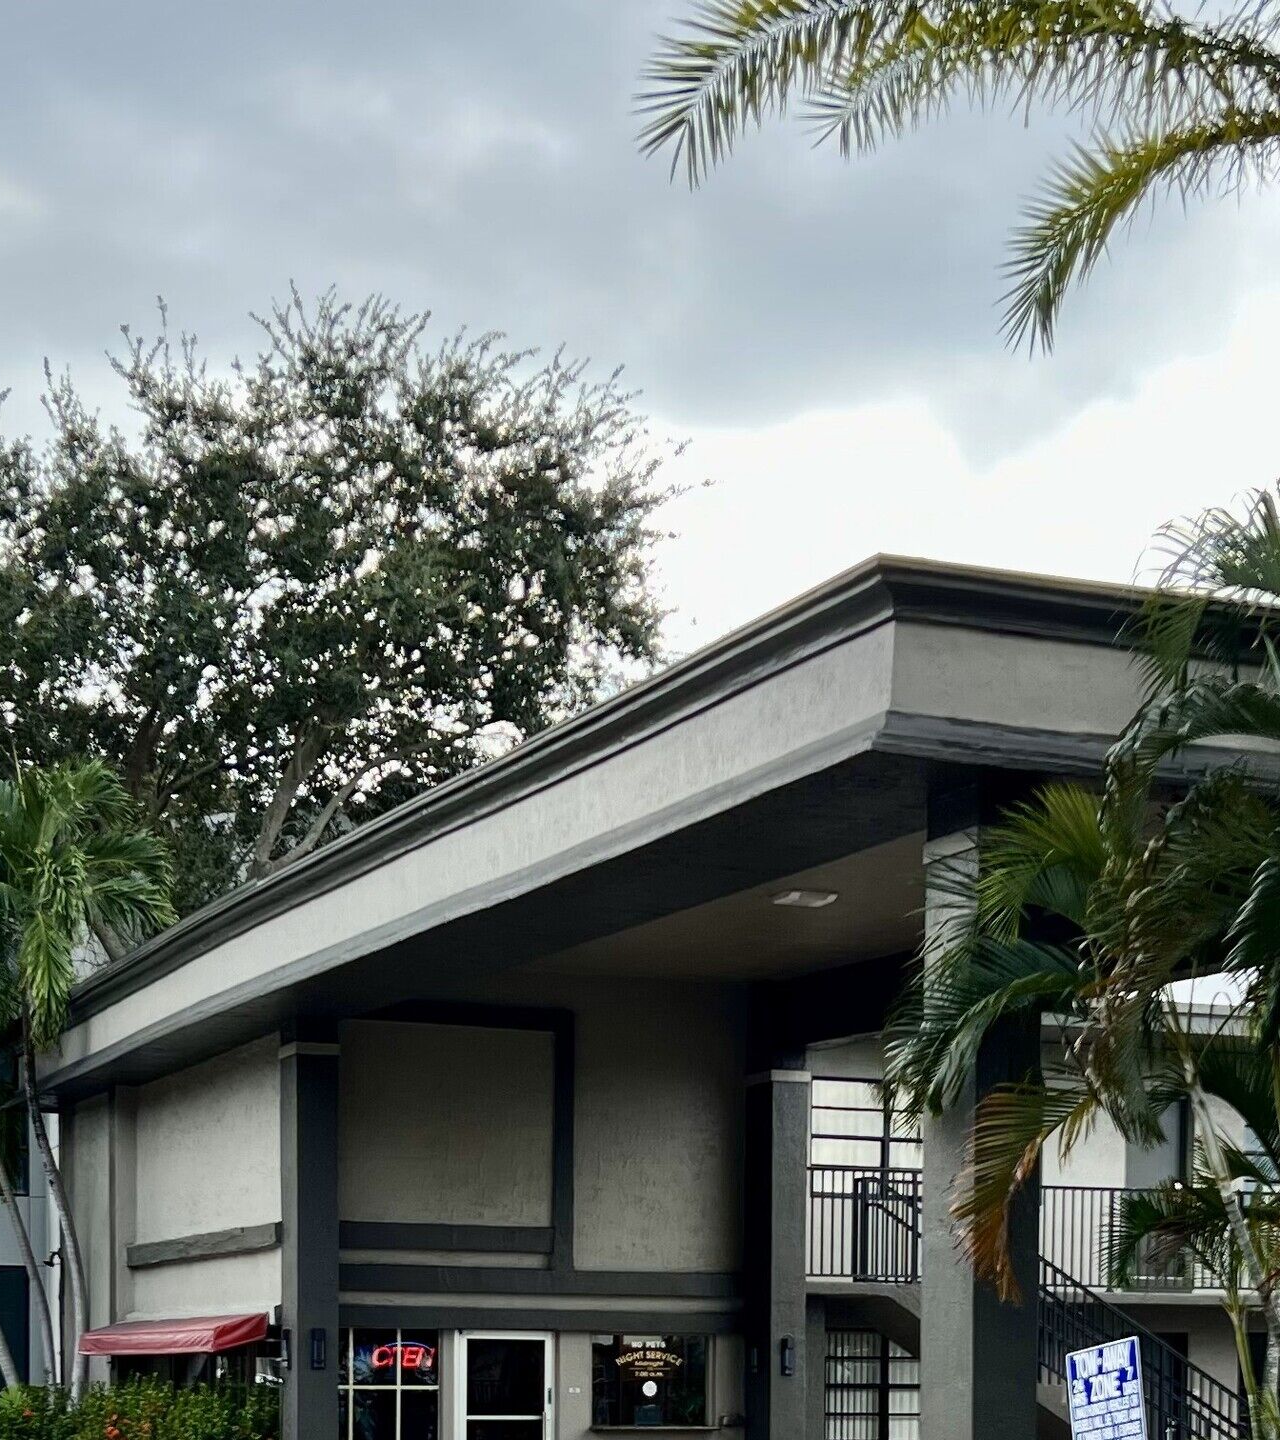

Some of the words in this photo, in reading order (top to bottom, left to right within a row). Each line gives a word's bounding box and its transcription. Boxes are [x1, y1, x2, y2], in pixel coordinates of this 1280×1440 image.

[615, 1351, 644, 1366] NIGHT
[646, 1351, 683, 1366] SERVICE
[1072, 1341, 1132, 1379] TOW-AWAY
[1089, 1371, 1122, 1402] ZONE
[1126, 1366, 1134, 1380] 7
